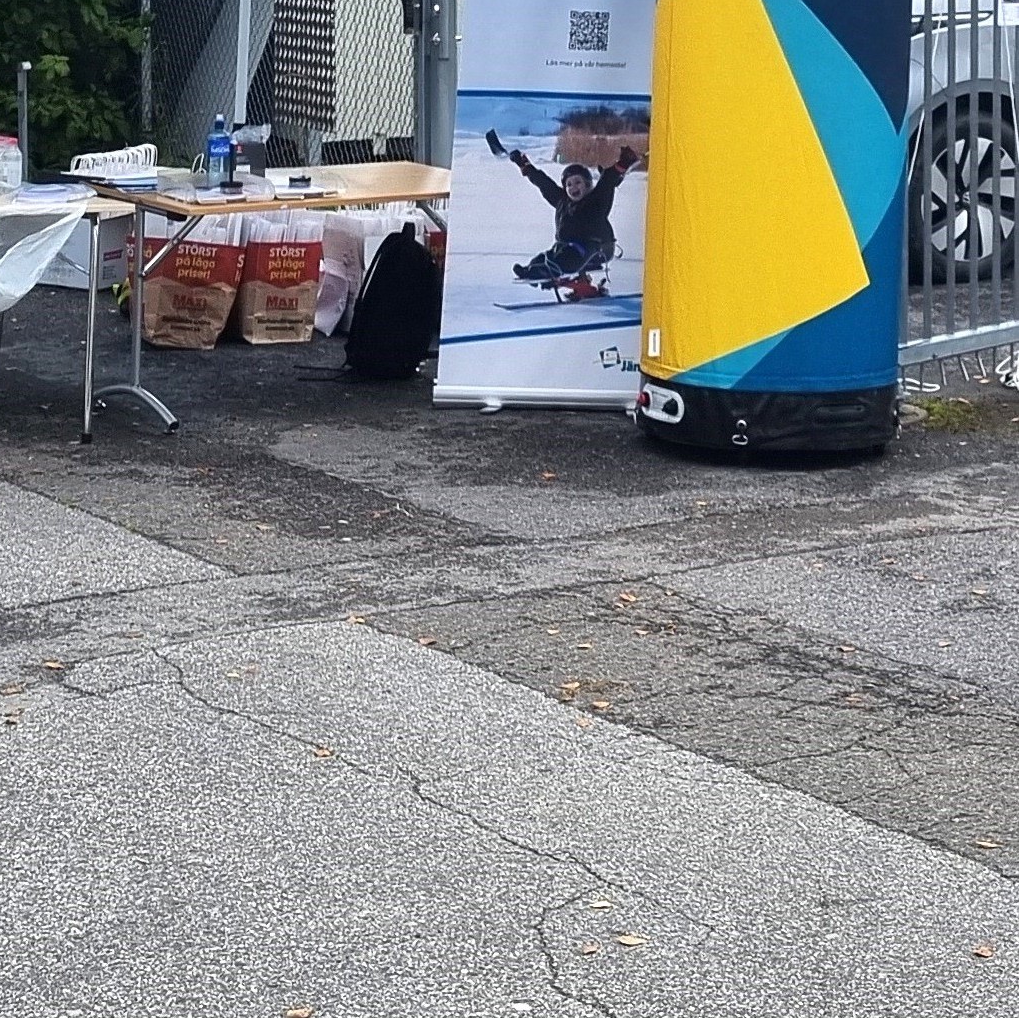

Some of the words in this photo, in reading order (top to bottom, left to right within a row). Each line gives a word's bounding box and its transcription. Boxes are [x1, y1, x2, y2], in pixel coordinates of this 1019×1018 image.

[177, 244, 217, 257] STÖRST
[269, 246, 306, 258] STÖRST
[175, 256, 191, 268] på
[192, 257, 216, 269] låga
[268, 257, 282, 269] på
[282, 258, 305, 270] låga
[177, 267, 211, 280] priser!
[270, 269, 301, 281] priser!
